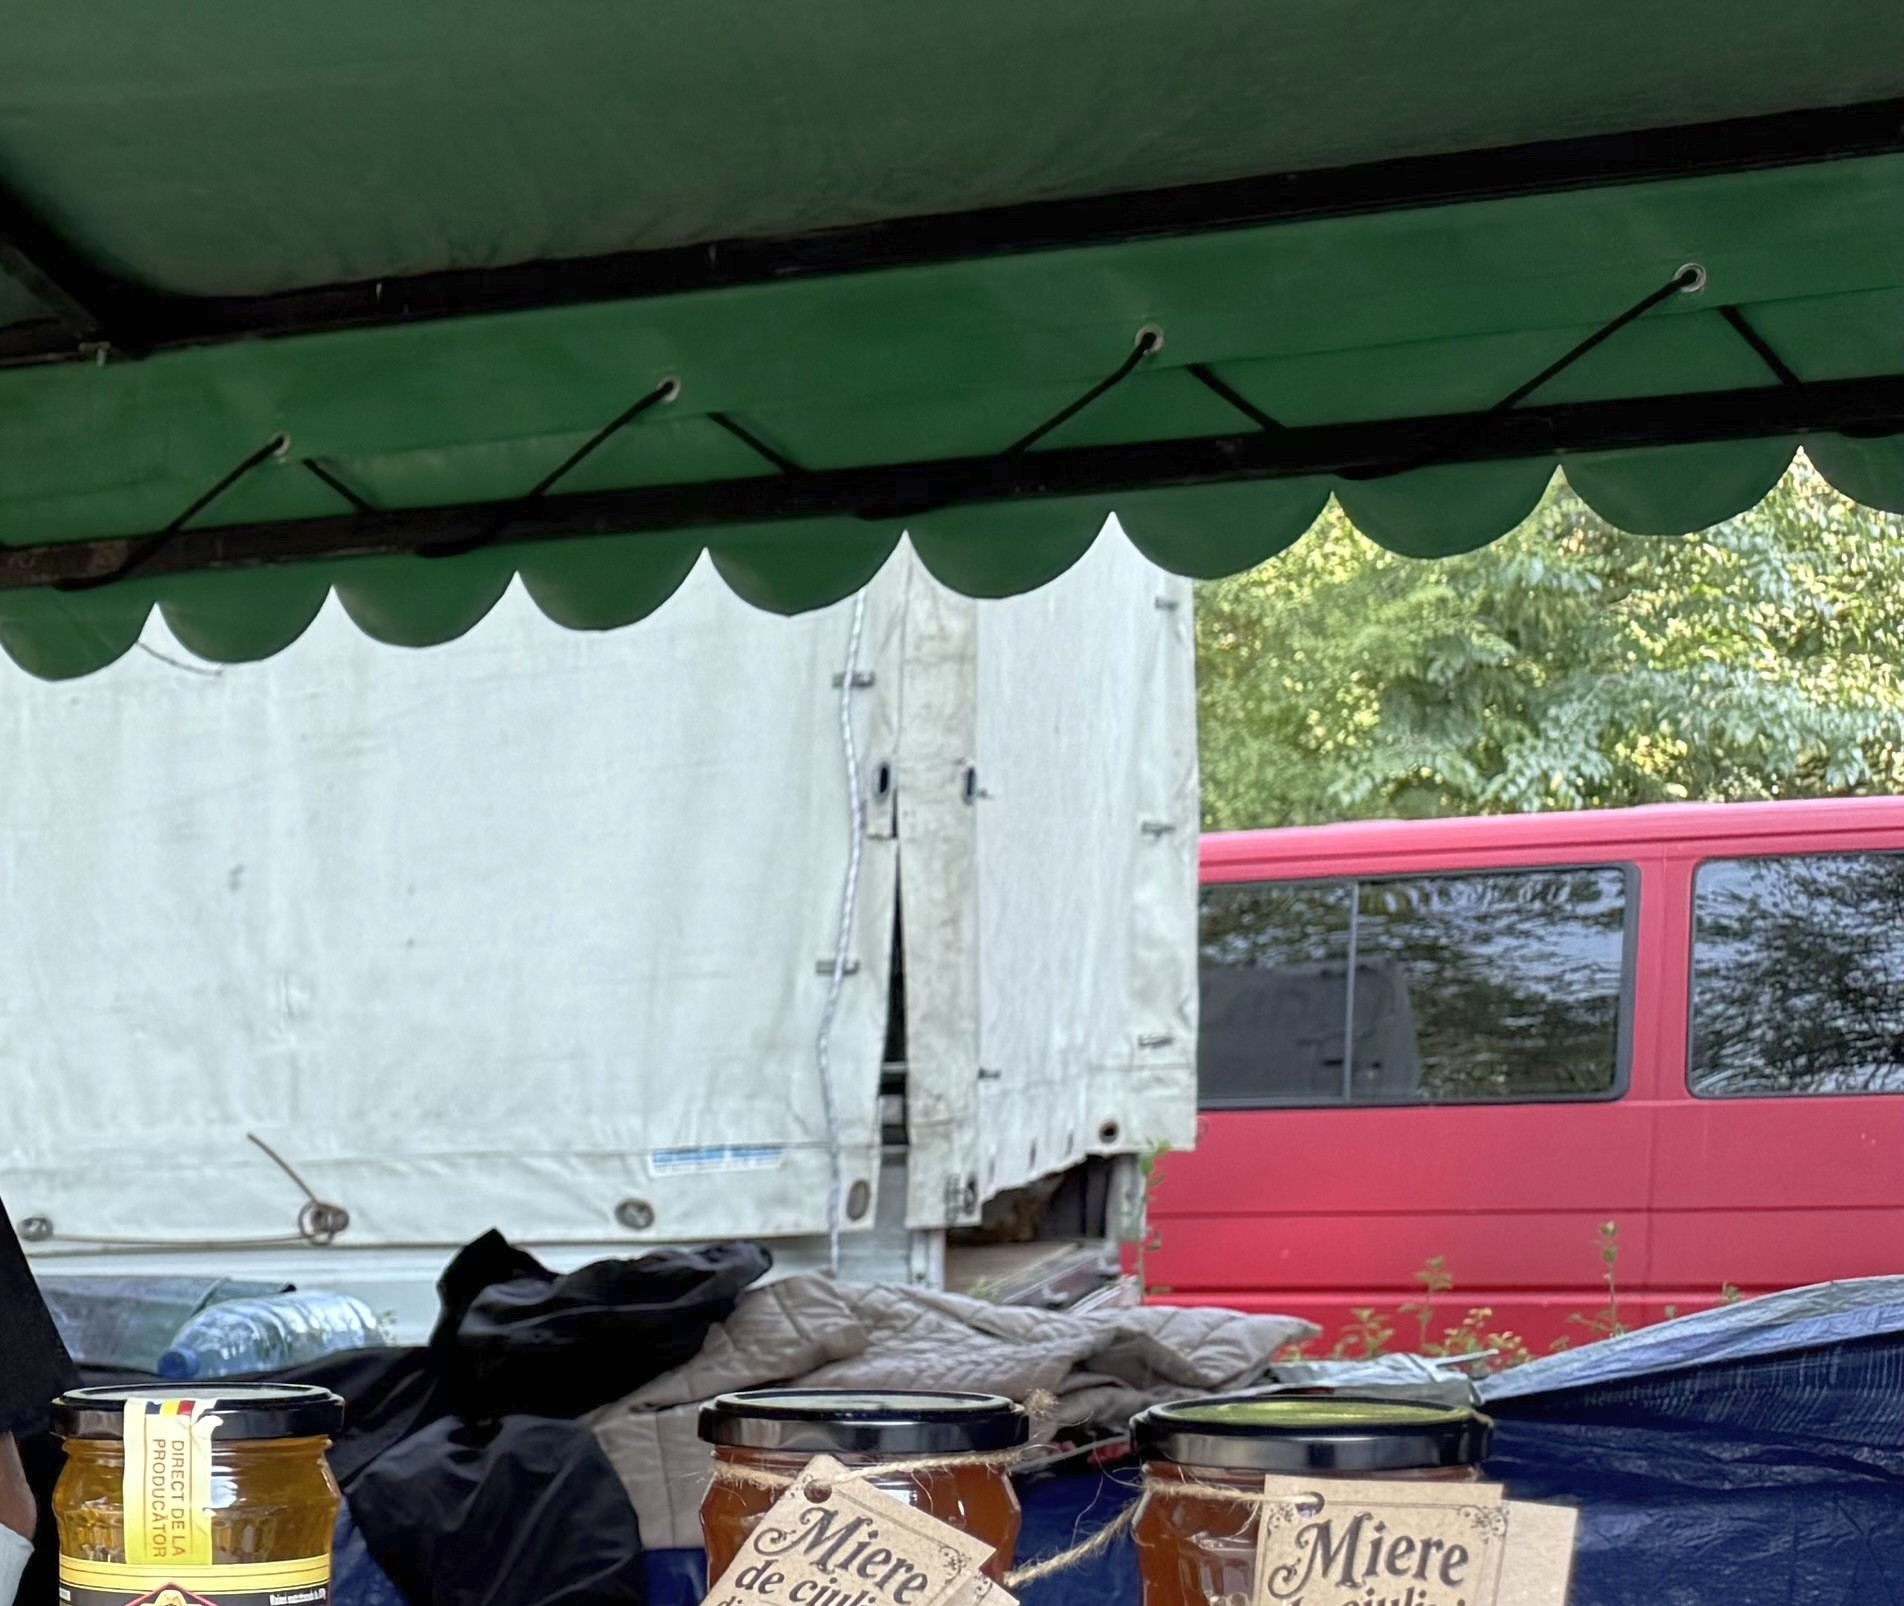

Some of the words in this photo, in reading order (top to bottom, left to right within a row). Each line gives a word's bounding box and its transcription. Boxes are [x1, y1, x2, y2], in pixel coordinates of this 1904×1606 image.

[172, 1440, 185, 1504] DIRECT
[172, 1510, 185, 1532] DE
[173, 1536, 186, 1557] LA
[754, 1506, 928, 1605] Miere
[1268, 1512, 1469, 1599] Miere
[735, 1559, 785, 1595] de
